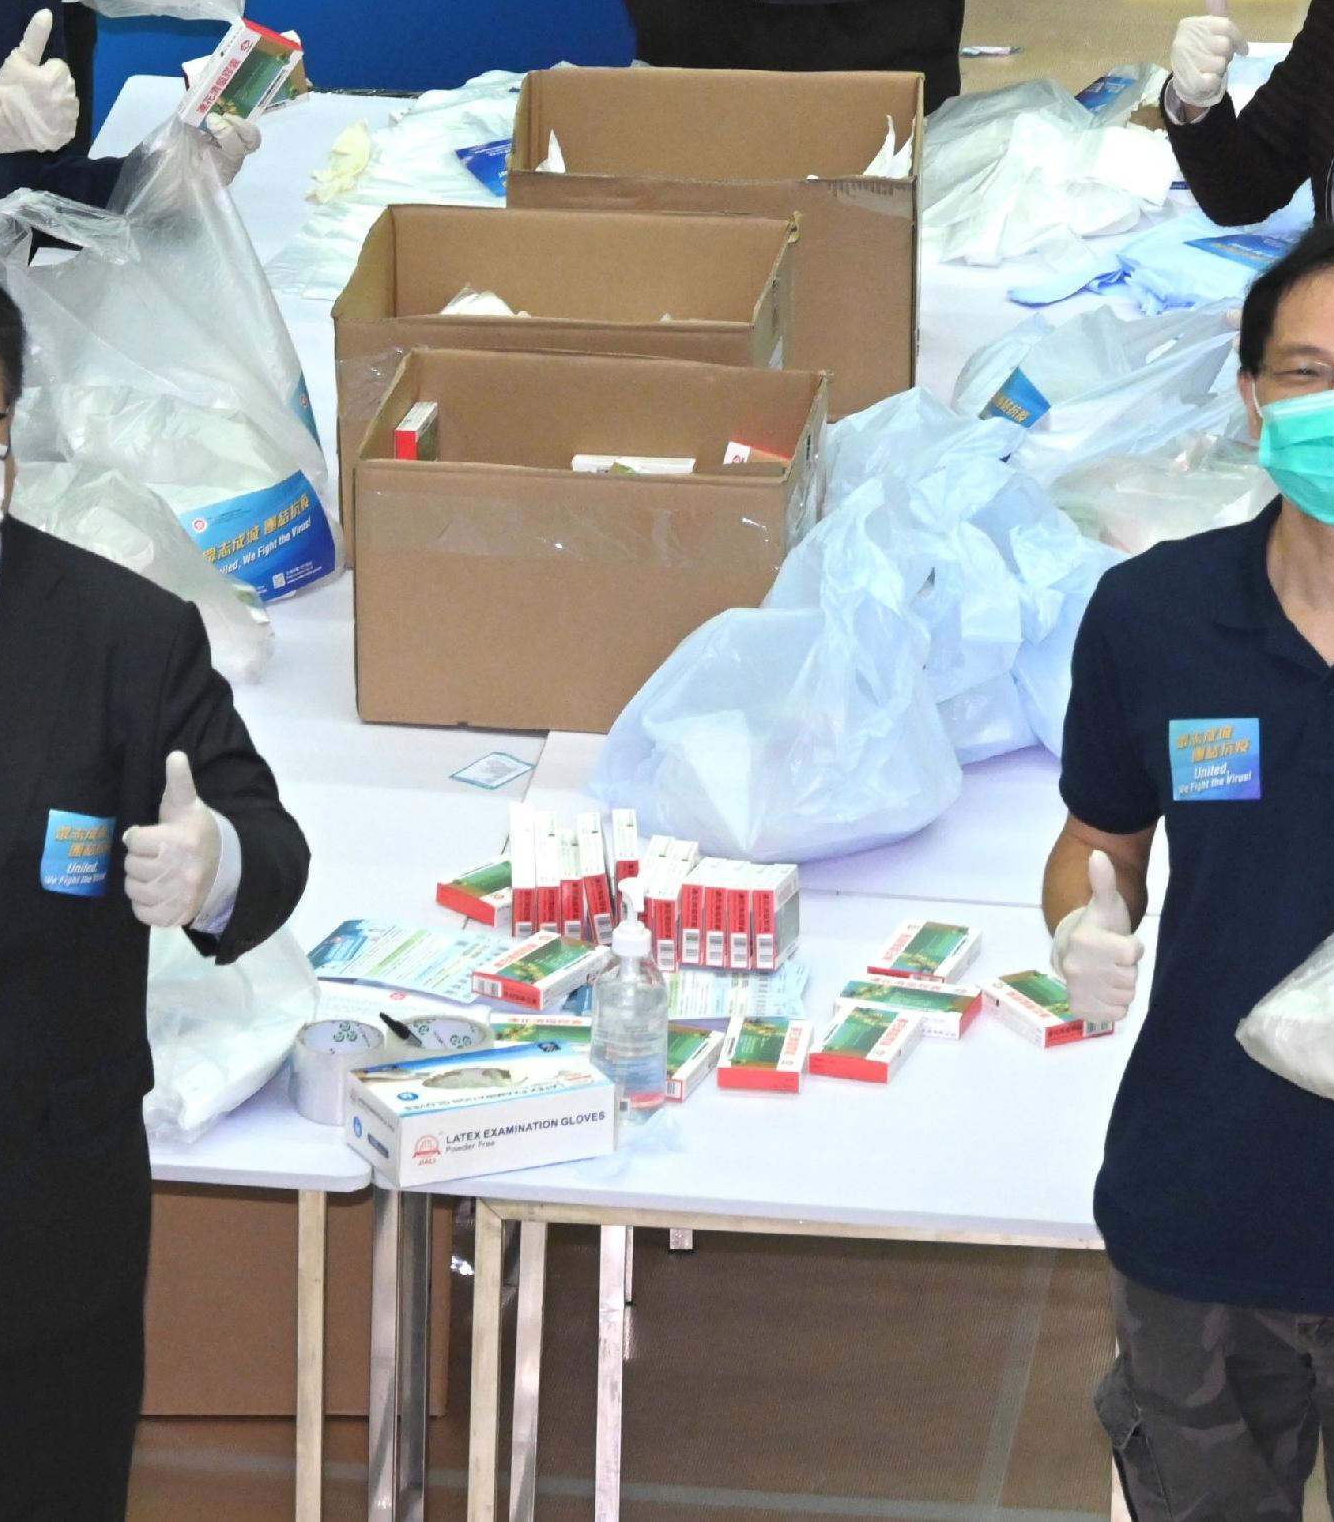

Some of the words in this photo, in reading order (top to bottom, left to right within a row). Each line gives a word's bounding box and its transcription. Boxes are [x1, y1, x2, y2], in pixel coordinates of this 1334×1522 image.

[243, 552, 257, 566] We
[257, 539, 278, 559] Fight
[446, 1130, 481, 1145] LATEX
[483, 1116, 559, 1140] EXAMINATION
[560, 1110, 606, 1127] GLOVES
[445, 1142, 476, 1154] Powder
